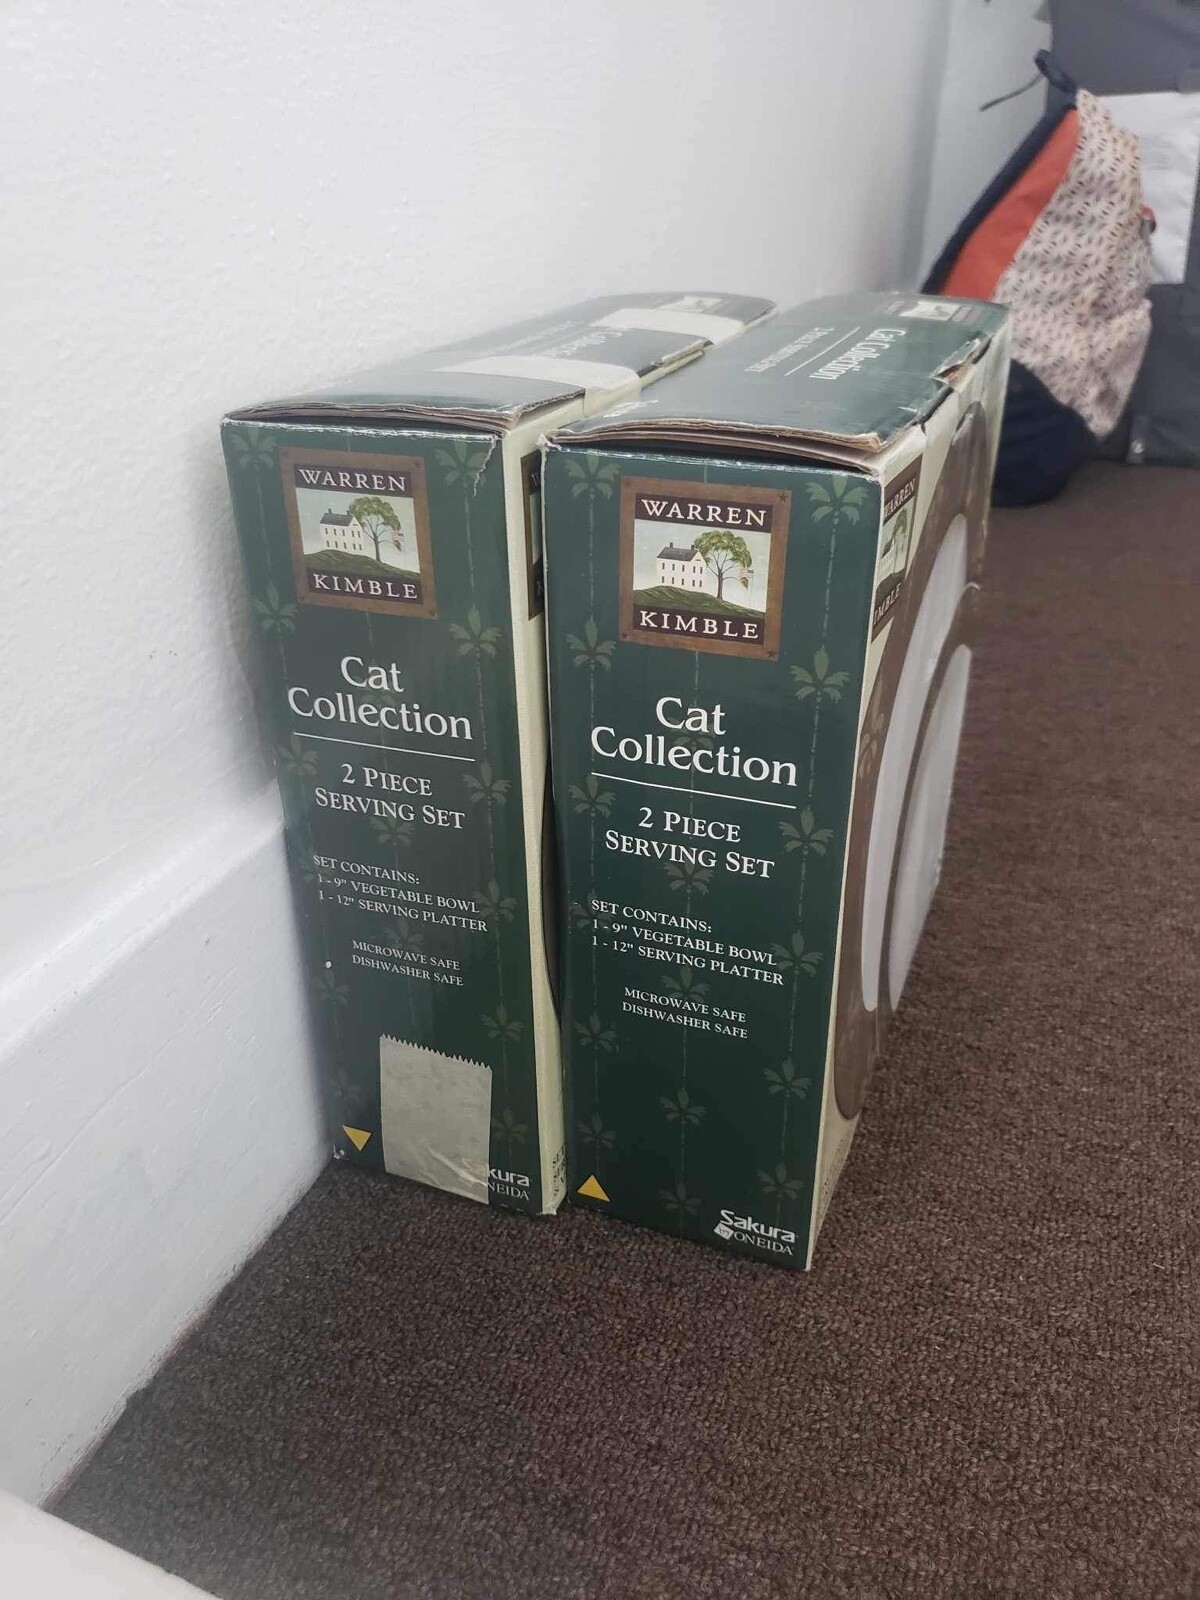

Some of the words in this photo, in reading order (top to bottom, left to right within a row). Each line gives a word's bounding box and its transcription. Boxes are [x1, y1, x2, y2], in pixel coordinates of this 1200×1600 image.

[299, 468, 406, 492] WARREN
[641, 499, 767, 527] WARREN
[312, 573, 418, 600] KIMBLE
[639, 610, 759, 640] KIMBLE
[340, 656, 404, 693] Cat
[287, 686, 473, 740] Collection
[655, 696, 727, 736] Cat
[590, 725, 799, 787] Collection
[341, 763, 356, 784] 2
[363, 766, 433, 796] PIECE
[315, 787, 415, 822] SERVING
[422, 804, 466, 830] SET
[638, 806, 654, 828] 2
[663, 810, 741, 843] PIECE
[313, 854, 337, 869] SET
[340, 860, 420, 885] CONTAINS:
[605, 829, 717, 868] SERVING
[725, 850, 775, 879] SET
[318, 874, 323, 883] 1
[334, 878, 347, 888] 9"
[350, 880, 433, 905] VEGETABLE
[436, 896, 480, 914] BOWL
[318, 890, 324, 901] 1
[337, 894, 354, 906] 12"
[358, 899, 419, 919] SERVING
[422, 911, 488, 932] PLATTER
[591, 899, 620, 915] SET
[623, 906, 712, 933] CONTAINS:
[352, 940, 428, 965] MICROWAVE
[430, 956, 461, 971] SAFE
[592, 935, 598, 946] 1
[613, 940, 634, 953] 12"
[638, 946, 706, 968] SERVING
[710, 959, 785, 986] PLATTER
[593, 919, 598, 929] 1
[612, 923, 628, 933] 9"
[632, 926, 725, 955] VEGETABLE
[728, 945, 778, 966] BOWL
[352, 955, 431, 981] DISHWASHER
[433, 972, 464, 987] SAFE
[622, 1001, 711, 1031] DISHWASHER
[714, 1023, 749, 1039] SAFE
[624, 986, 710, 1015] MICROWAVE
[712, 1006, 747, 1023] SAFE
[719, 1208, 796, 1244] Sakura
[733, 1230, 794, 1257] ONEIDA
